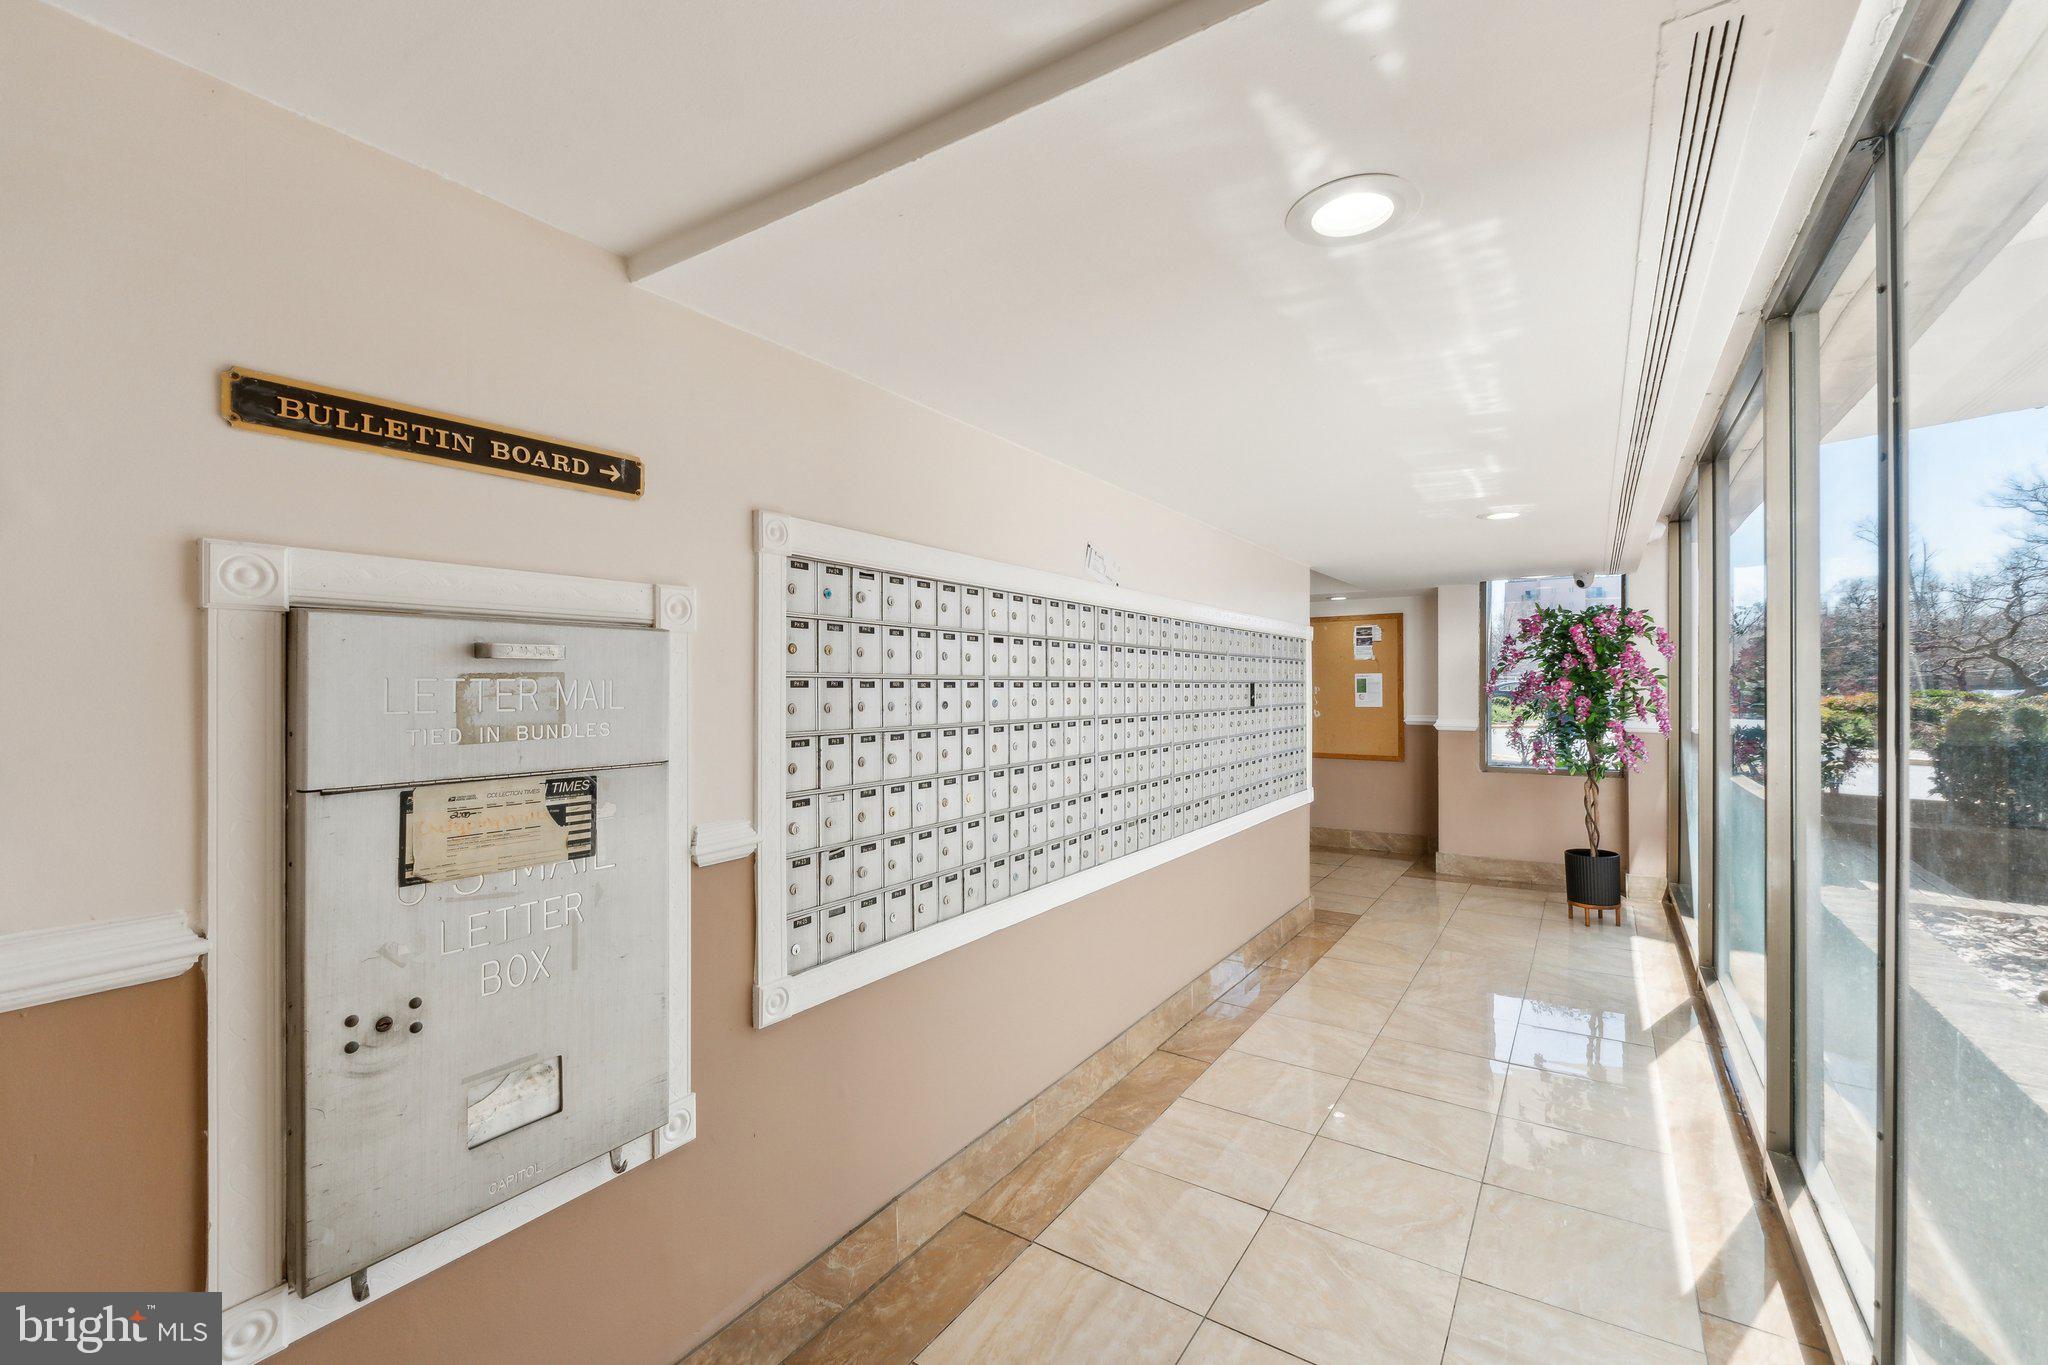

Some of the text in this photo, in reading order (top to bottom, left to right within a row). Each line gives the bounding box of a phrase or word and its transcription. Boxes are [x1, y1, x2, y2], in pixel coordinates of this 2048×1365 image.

[276, 396, 590, 476] BULLETIN BOARD
[383, 676, 625, 715] LETTER MAIL
[406, 722, 612, 747] TIED IN BUNDLES
[486, 789, 524, 799] COLLECTION
[524, 788, 541, 796] TIMES
[551, 779, 591, 794] TIMES
[440, 892, 585, 956] LETTER
[480, 946, 552, 998] BOX
[488, 1163, 544, 1195] CAPITOL
